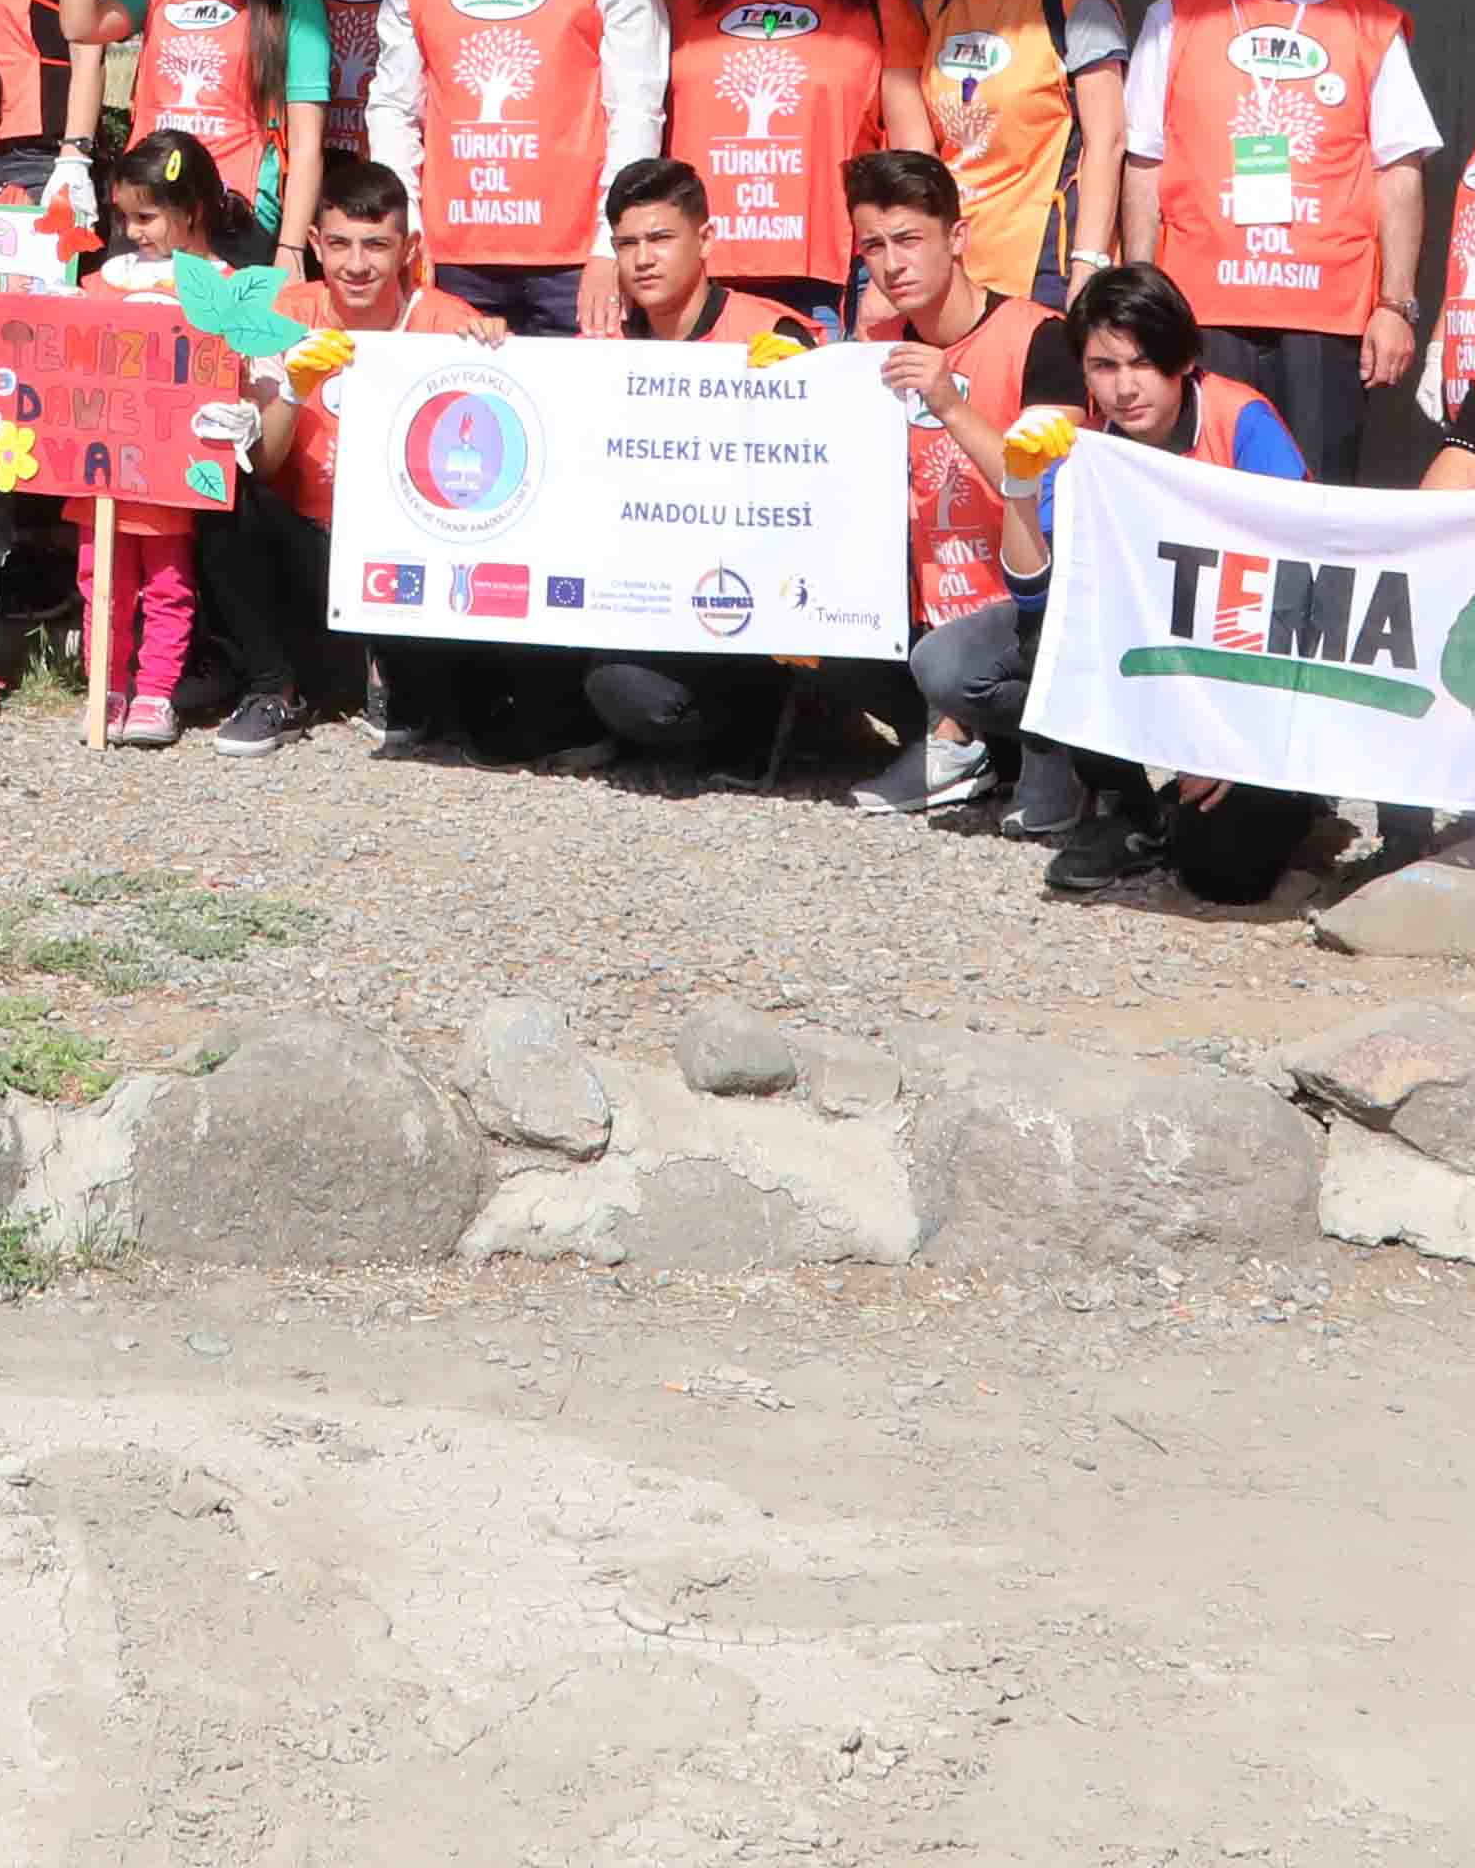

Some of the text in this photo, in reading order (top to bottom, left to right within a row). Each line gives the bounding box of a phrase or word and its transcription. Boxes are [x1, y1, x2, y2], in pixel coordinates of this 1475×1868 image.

[1251, 36, 1301, 59] TEMA
[451, 128, 539, 159] TÜRKİYE
[709, 143, 803, 176] TÜRKİYE
[469, 161, 511, 198] ÇÖL
[736, 176, 780, 214] ÇÖL
[448, 199, 540, 225] OLMASIN
[710, 215, 804, 241] OLMASIN
[1218, 259, 1322, 290] OLMASIN
[627, 372, 808, 401] İZMİR BAYRAKLI
[17, 383, 195, 442] DAVET
[607, 435, 829, 465] MESLEKİ VE TEKNİK
[42, 437, 149, 495] VAR
[620, 500, 813, 528] ANADOLU LİSESİ
[816, 607, 882, 630] Twinning
[1157, 540, 1418, 671] TEMA
